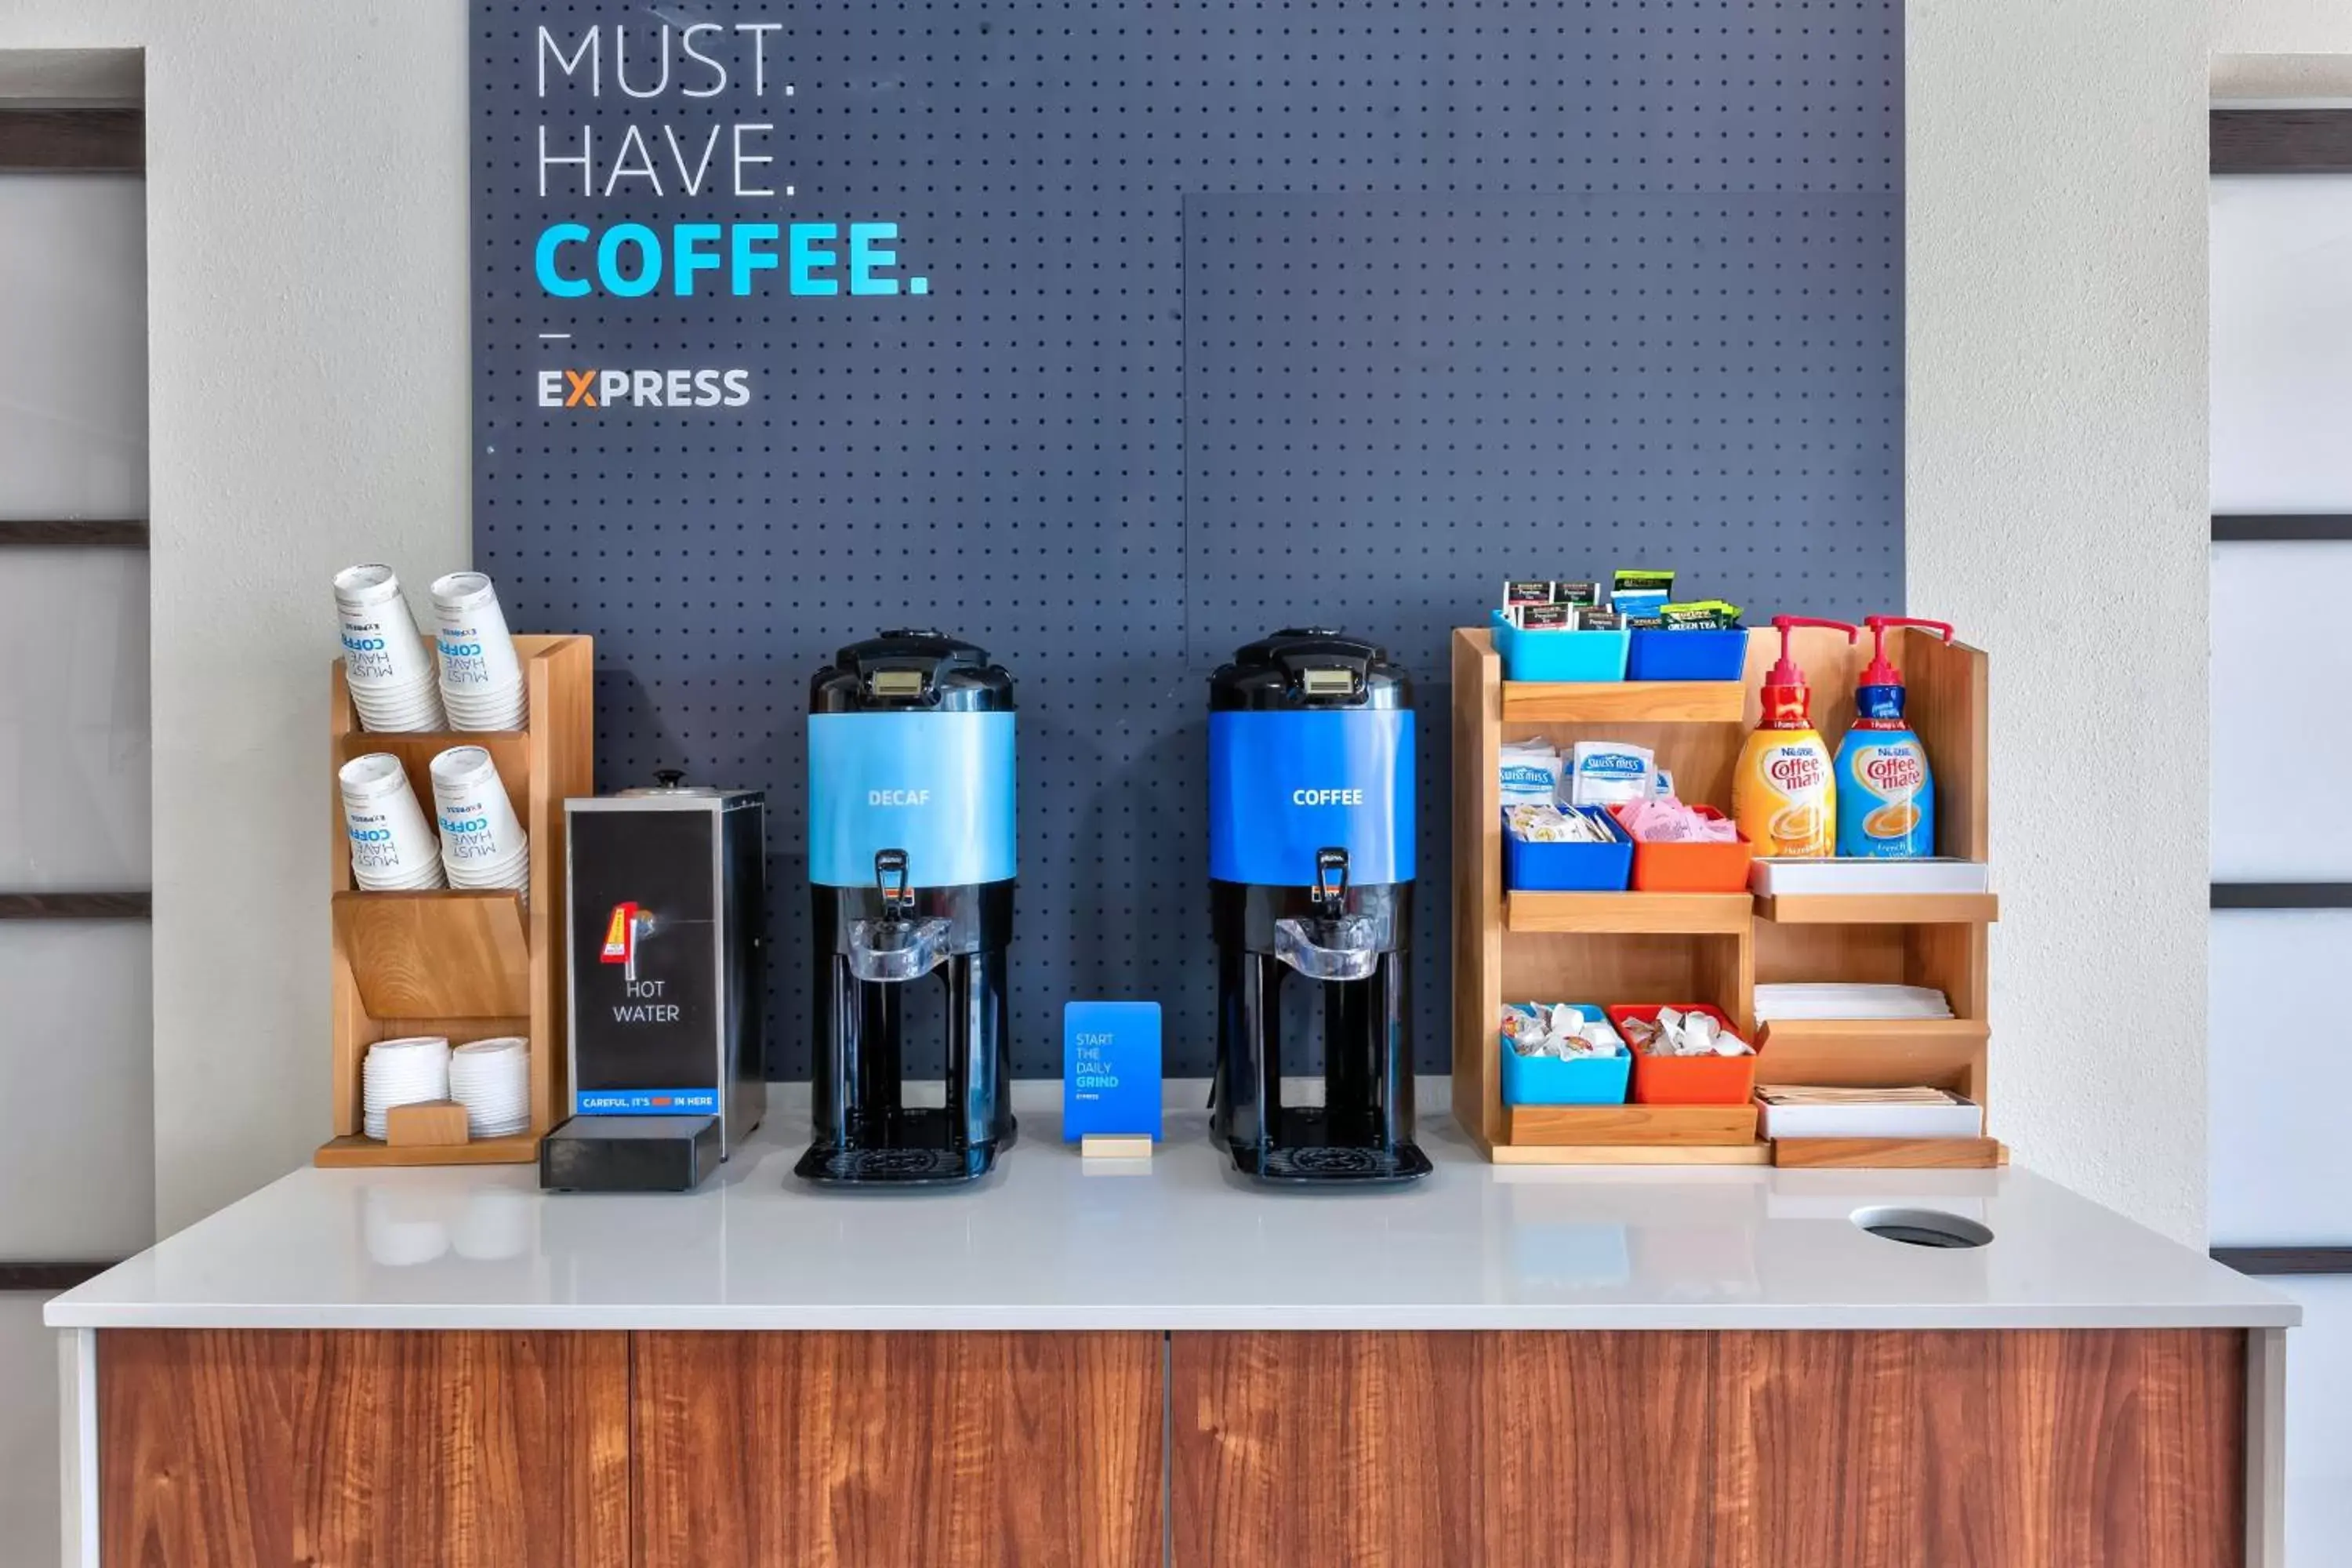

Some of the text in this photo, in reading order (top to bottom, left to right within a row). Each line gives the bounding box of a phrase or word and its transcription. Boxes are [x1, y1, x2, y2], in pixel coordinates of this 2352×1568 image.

[539, 24, 794, 98] MUST.
[539, 125, 794, 197] HAVE.
[535, 223, 928, 297] COFFEE.
[539, 369, 750, 407] EXPRESS
[1699, 620, 1717, 630] TEA
[1770, 757, 1819, 780] Coffee
[1867, 757, 1915, 780] Coffee
[1882, 771, 1920, 789] mate
[868, 789, 930, 806] DECAF
[1293, 789, 1363, 806] COFFEE
[626, 981, 666, 998] HOT
[612, 1004, 681, 1022] WATER
[1076, 1033, 1114, 1046] START
[1076, 1047, 1100, 1060] THE
[1076, 1061, 1112, 1074] DAILY
[1076, 1076, 1119, 1087] GRIND
[583, 1098, 630, 1108] CAREFUL,
[631, 1098, 651, 1107] IT'S
[674, 1097, 685, 1106] IN
[687, 1097, 713, 1106] HERE
